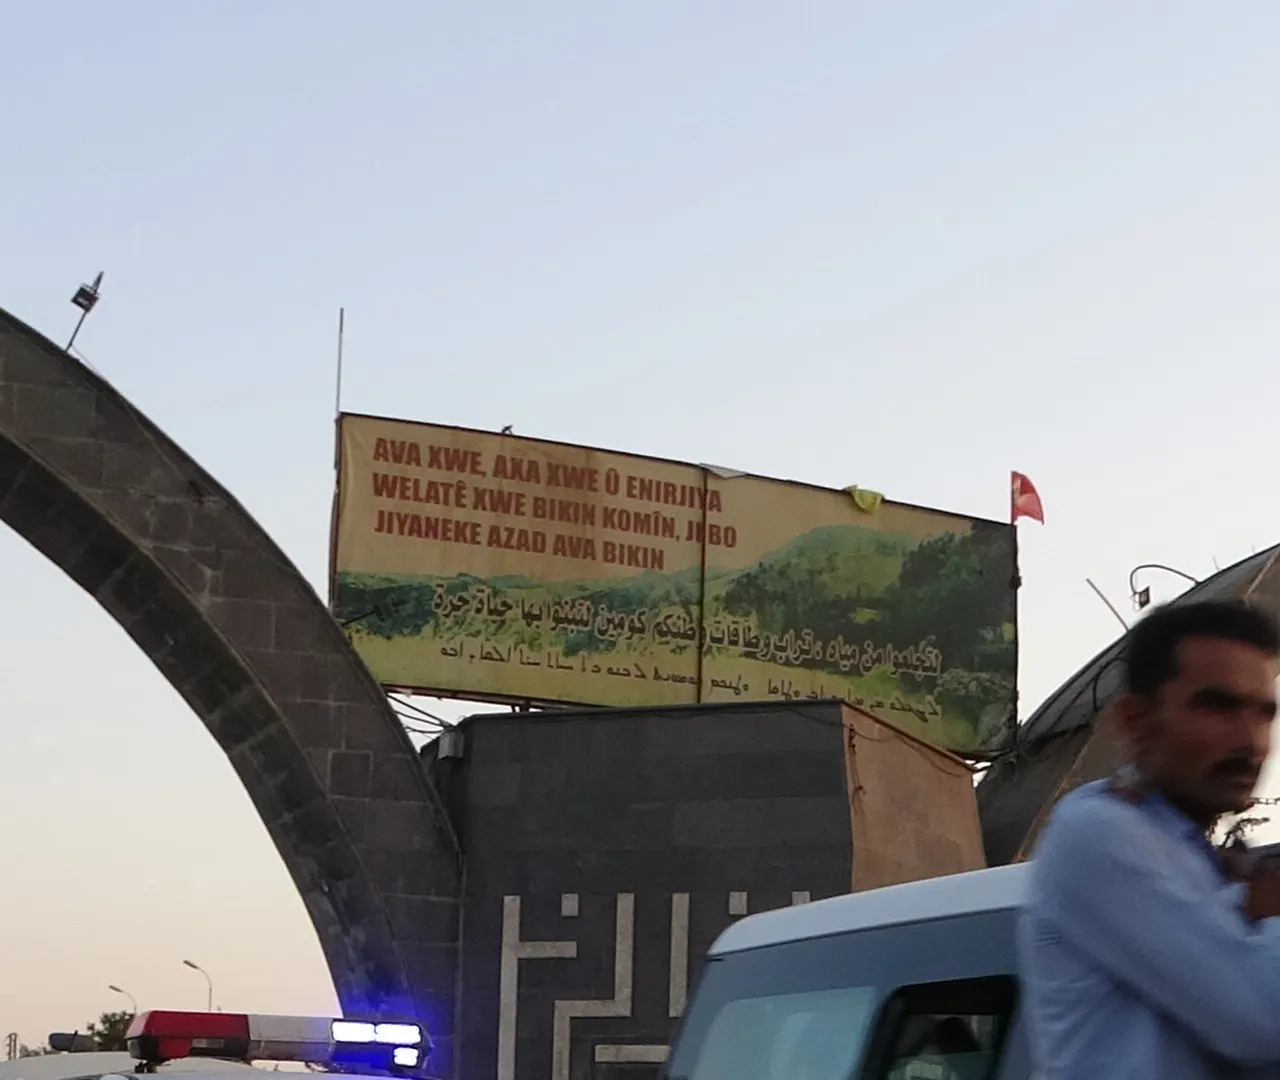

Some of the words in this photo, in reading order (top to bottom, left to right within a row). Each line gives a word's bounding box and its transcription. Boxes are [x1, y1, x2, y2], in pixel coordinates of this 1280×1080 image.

[373, 437, 421, 468] AVA
[428, 445, 486, 478] XWE,
[492, 454, 541, 484] AXA
[546, 463, 599, 493] XWE
[372, 472, 467, 508] WELATÊ
[472, 487, 526, 516] XWE
[532, 496, 595, 526] BIKIN
[602, 506, 680, 541] KOMÎN,
[708, 523, 737, 548] BO
[374, 510, 481, 545] JIYANEKE
[487, 525, 546, 554] AZAD
[552, 534, 596, 561] AVA
[602, 541, 665, 571] BIKIN
